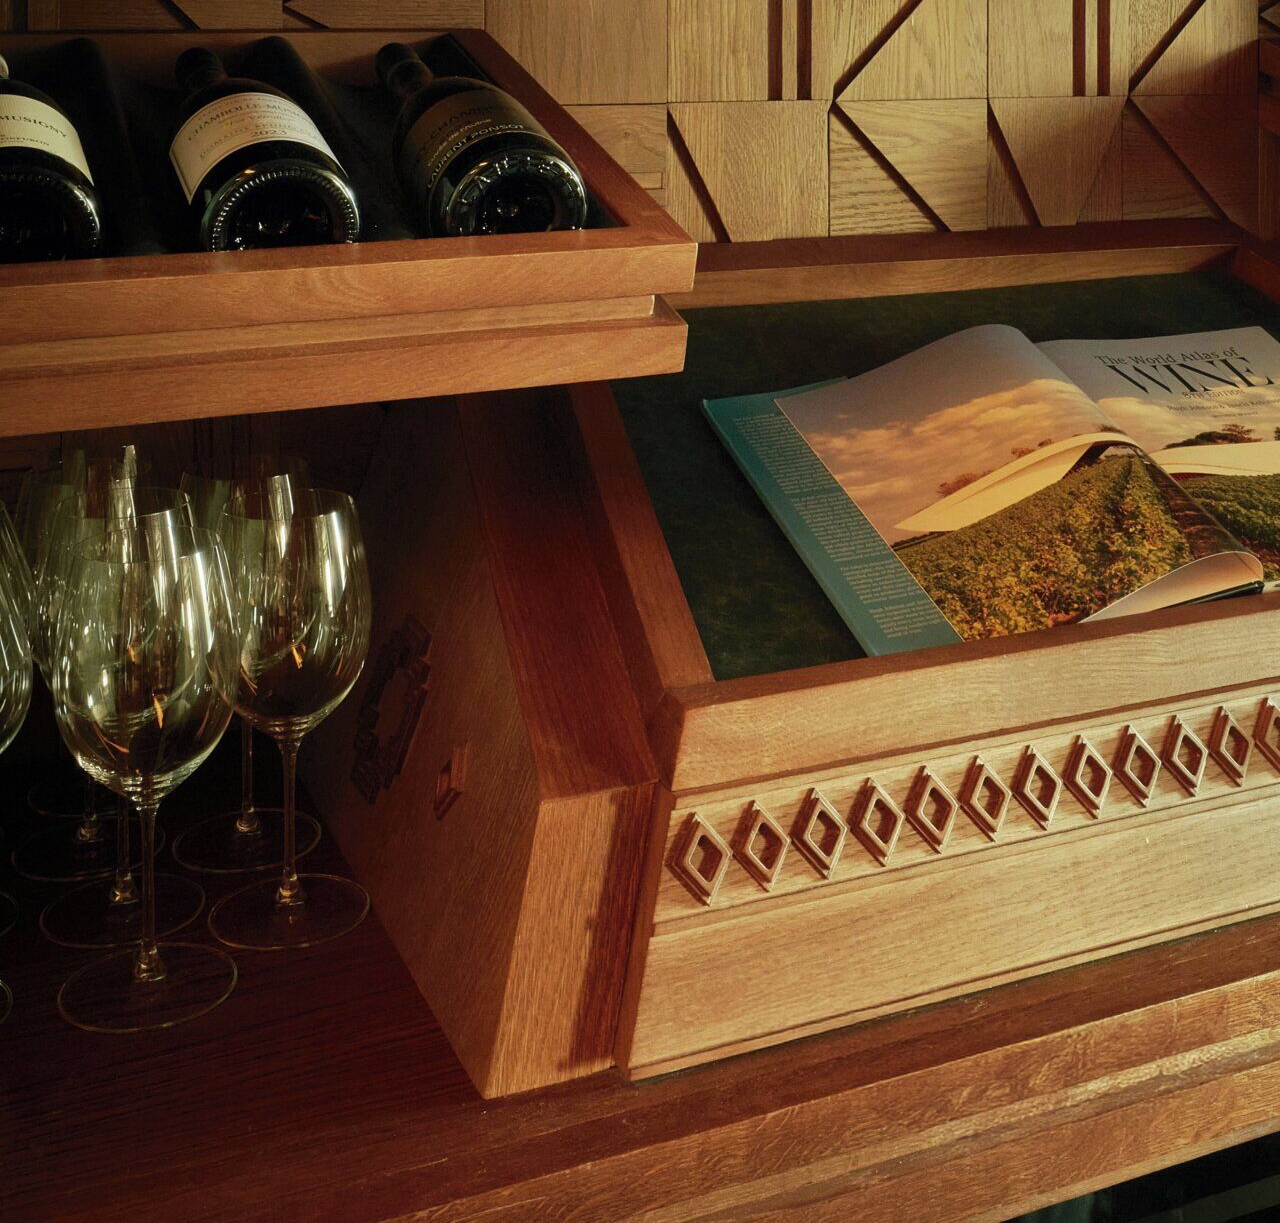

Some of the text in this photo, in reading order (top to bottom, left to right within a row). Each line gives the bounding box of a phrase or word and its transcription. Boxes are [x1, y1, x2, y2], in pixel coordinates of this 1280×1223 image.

[1094, 346, 1239, 365] The World Atlas of
[1105, 356, 1276, 394] WINE
